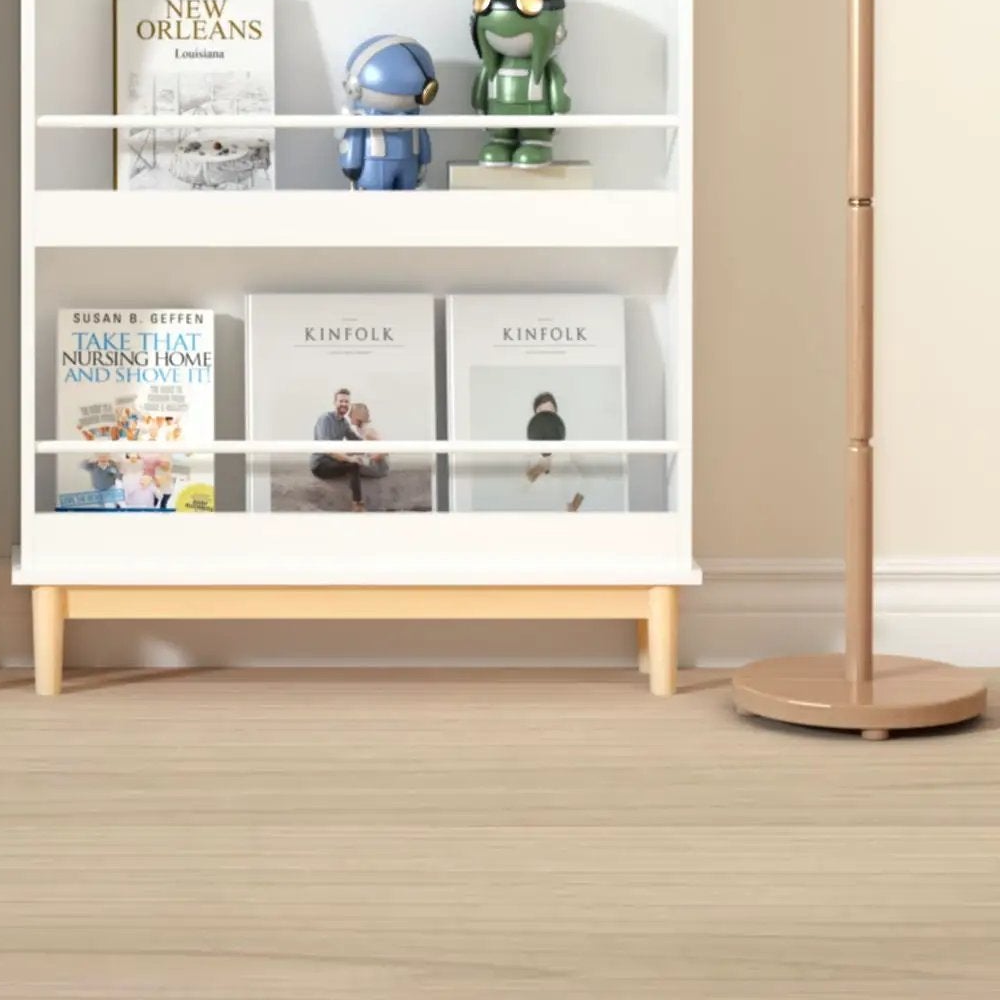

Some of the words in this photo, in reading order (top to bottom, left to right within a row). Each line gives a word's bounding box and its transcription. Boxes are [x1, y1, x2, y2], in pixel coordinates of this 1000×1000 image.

[165, 0, 228, 19] NEW
[136, 19, 263, 40] ORLEANS
[174, 48, 225, 59] Louisiana
[73, 312, 122, 324] SUSAN
[129, 312, 144, 324] B.
[150, 312, 204, 324] GEFFEN
[72, 332, 130, 351] TAKE
[138, 332, 202, 351] THAT
[304, 327, 394, 342] KINFOLK
[503, 327, 587, 342] KINFOLK
[62, 351, 149, 367] NURSING
[155, 351, 212, 367] HOME
[64, 367, 110, 383] AND
[115, 367, 178, 383] SHOVE
